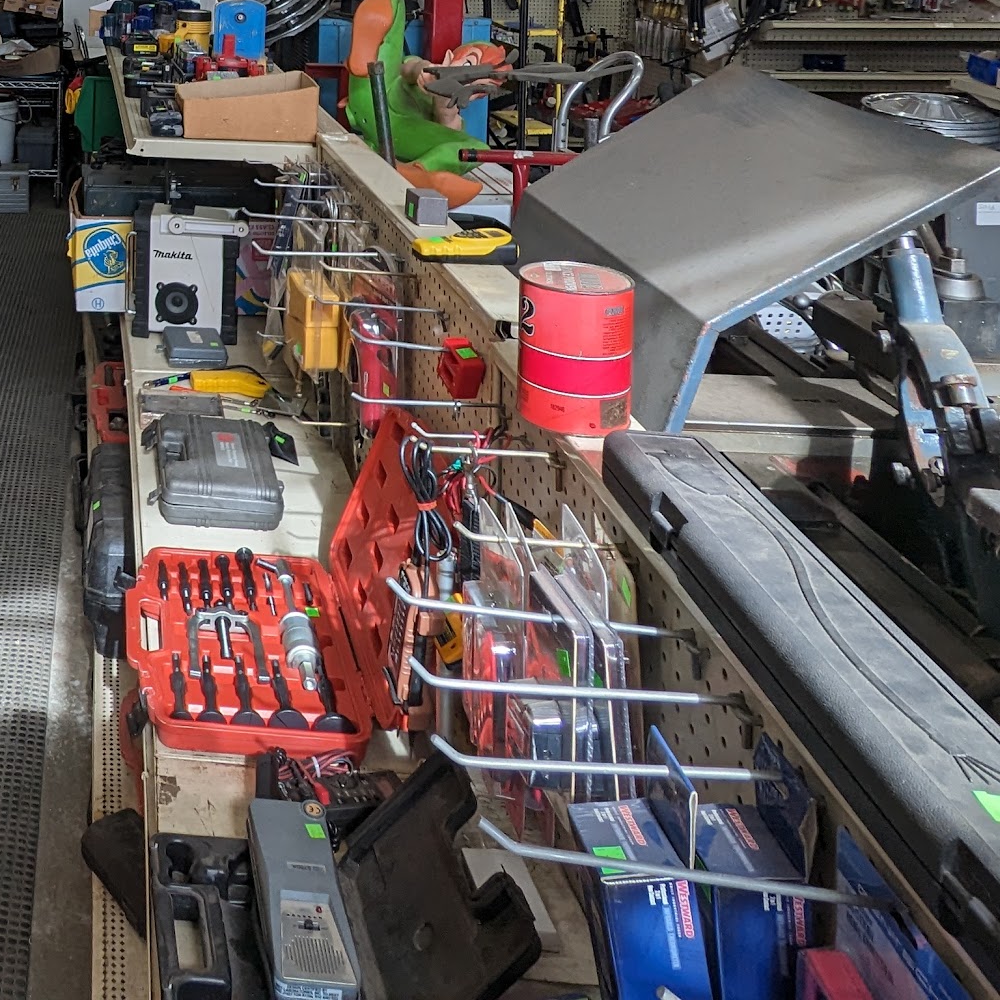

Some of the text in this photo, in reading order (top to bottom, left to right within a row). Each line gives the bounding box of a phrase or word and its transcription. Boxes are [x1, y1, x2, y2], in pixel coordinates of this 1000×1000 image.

[85, 233, 122, 259] Chiquita
[617, 804, 648, 846] WESTWARD
[725, 807, 761, 851] WESTWARD
[675, 879, 695, 940] WESTWARD
